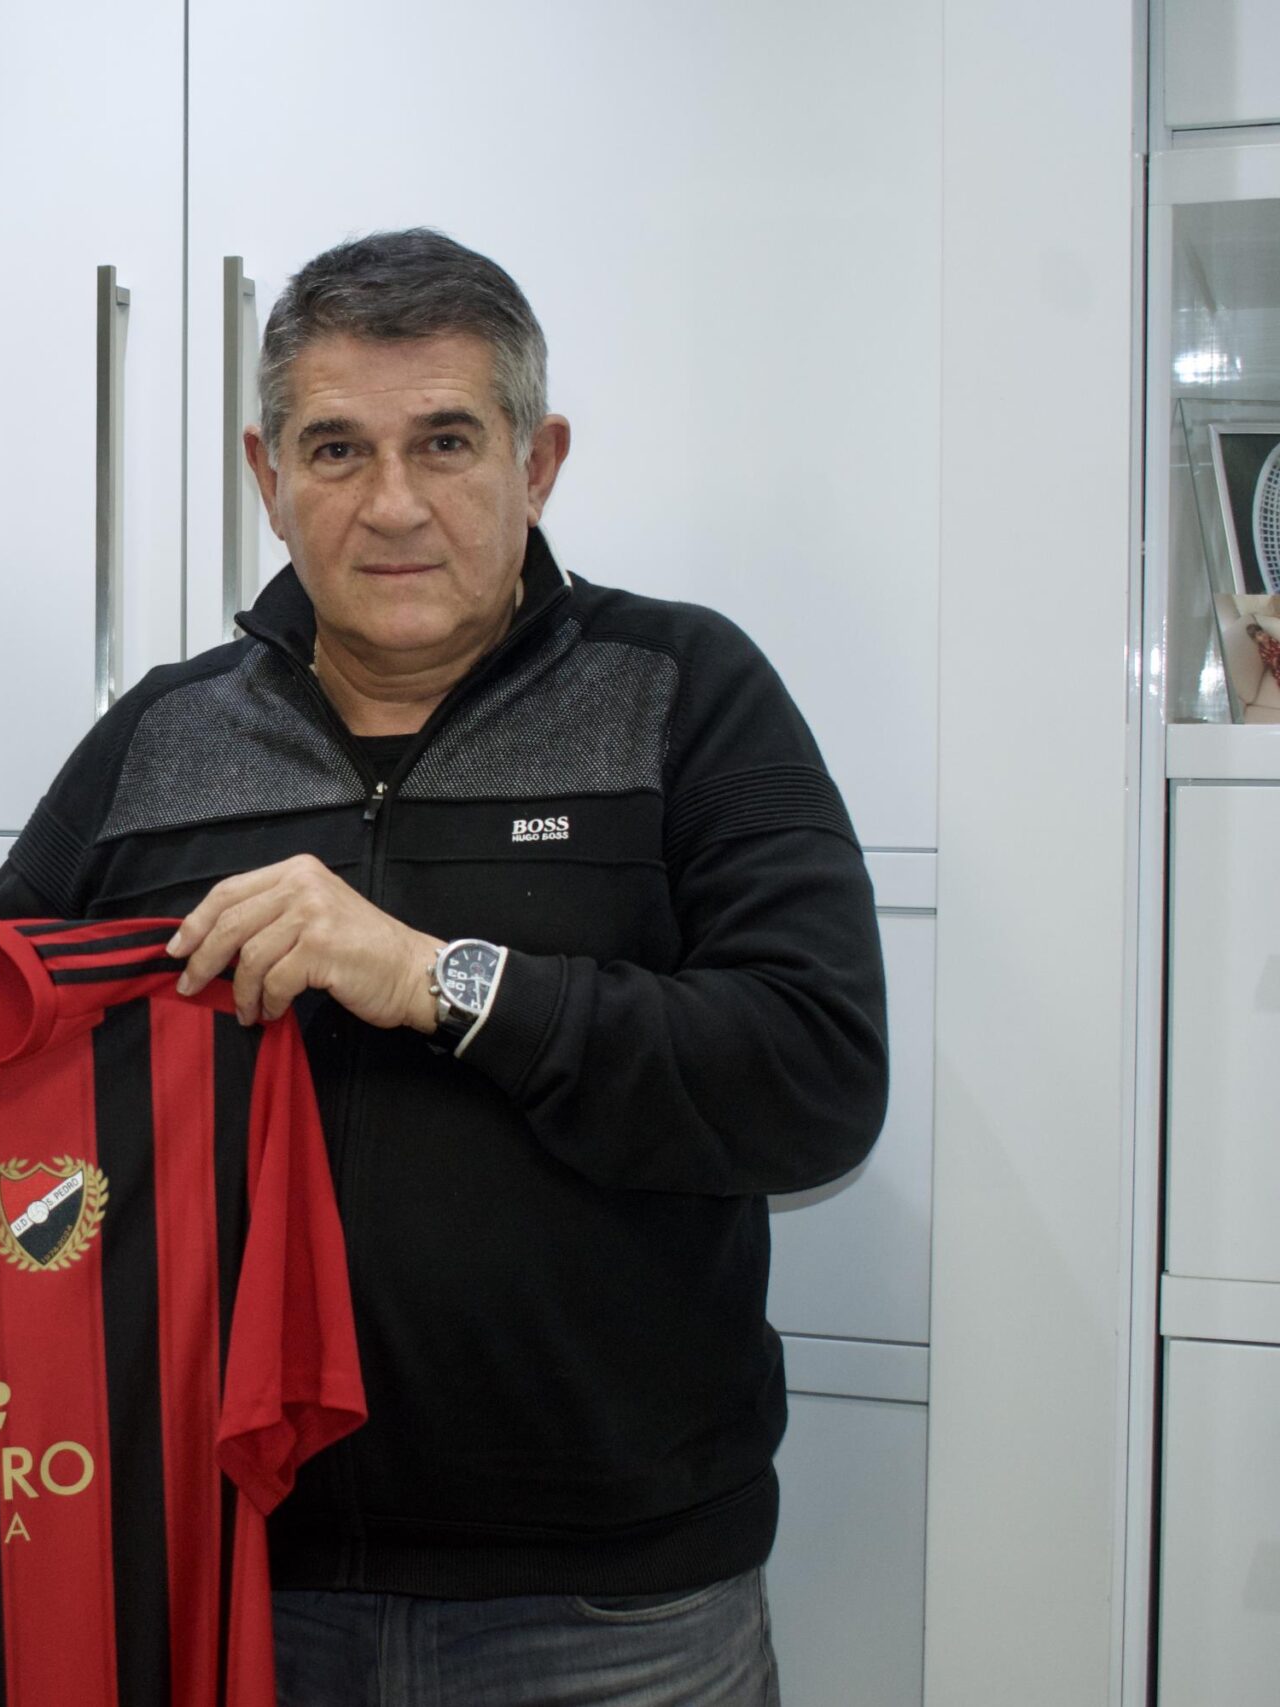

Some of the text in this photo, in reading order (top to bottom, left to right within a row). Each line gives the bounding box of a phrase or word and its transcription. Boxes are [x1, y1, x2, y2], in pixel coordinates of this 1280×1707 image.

[512, 816, 569, 834] BOSS
[512, 831, 569, 843] HUGO BOSS
[54, 1177, 79, 1200] PEDRO
